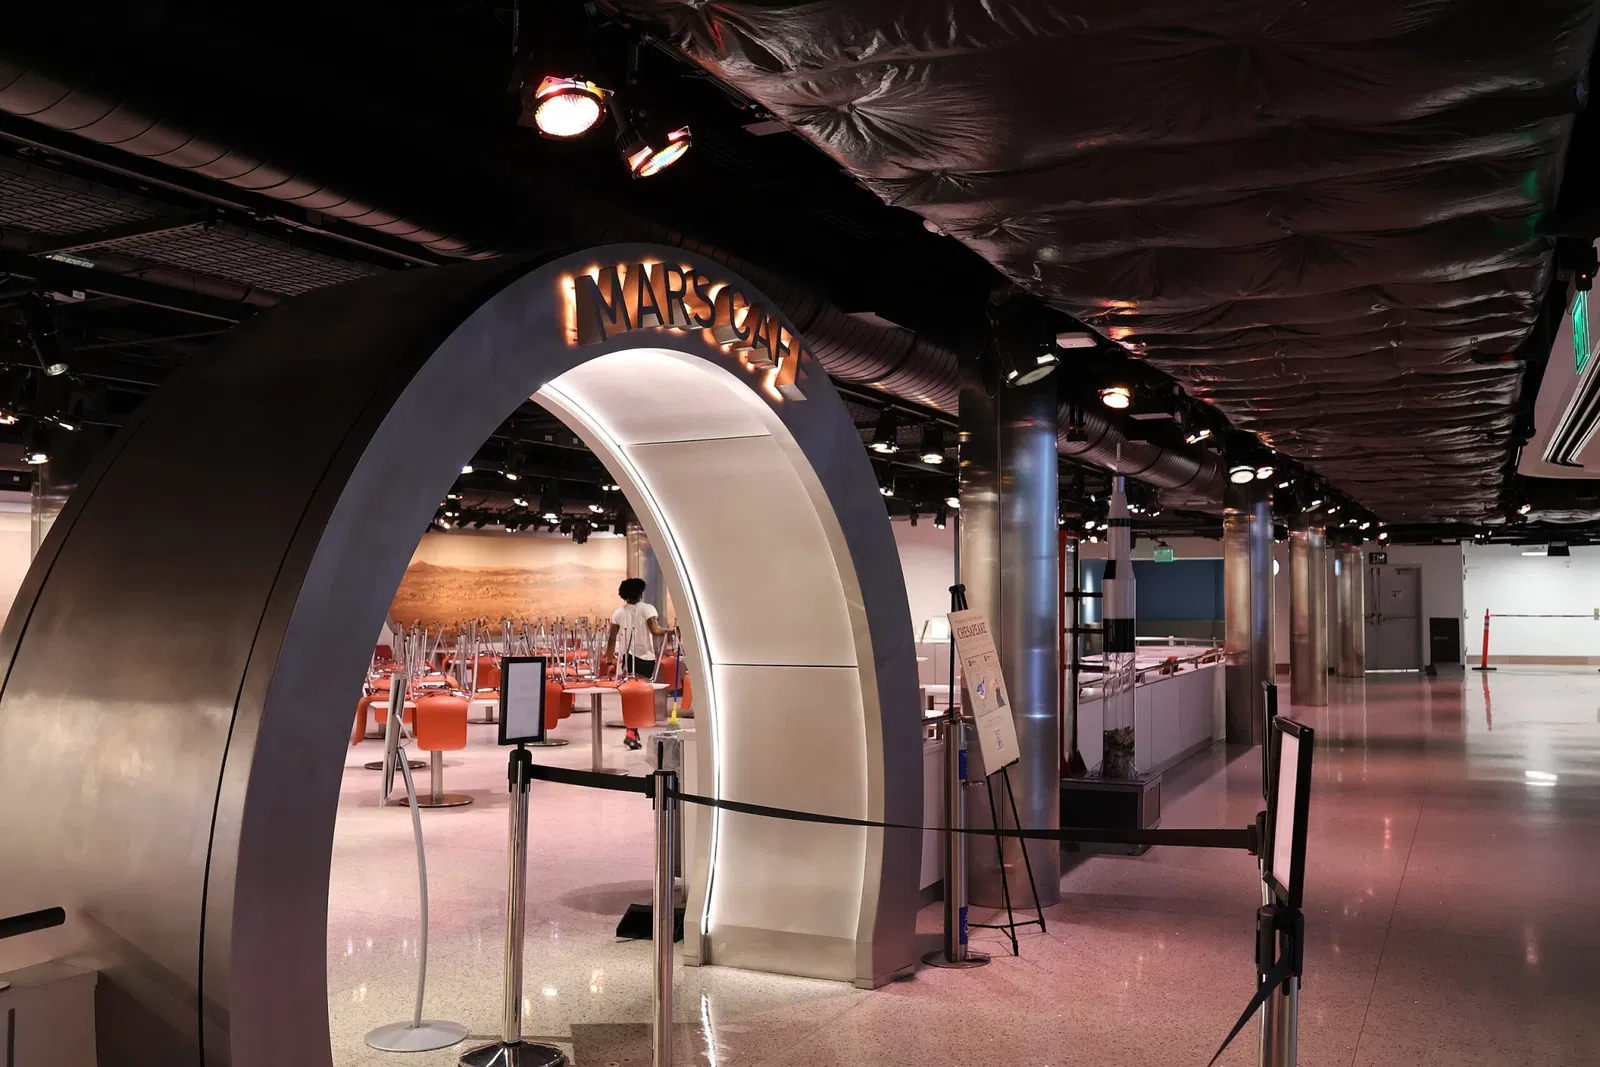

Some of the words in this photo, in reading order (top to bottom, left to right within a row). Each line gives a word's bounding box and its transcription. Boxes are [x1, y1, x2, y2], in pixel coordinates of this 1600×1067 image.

[577, 262, 716, 343] MARS
[724, 287, 814, 400] CAFE
[957, 623, 987, 639] CHESAPEAKE
